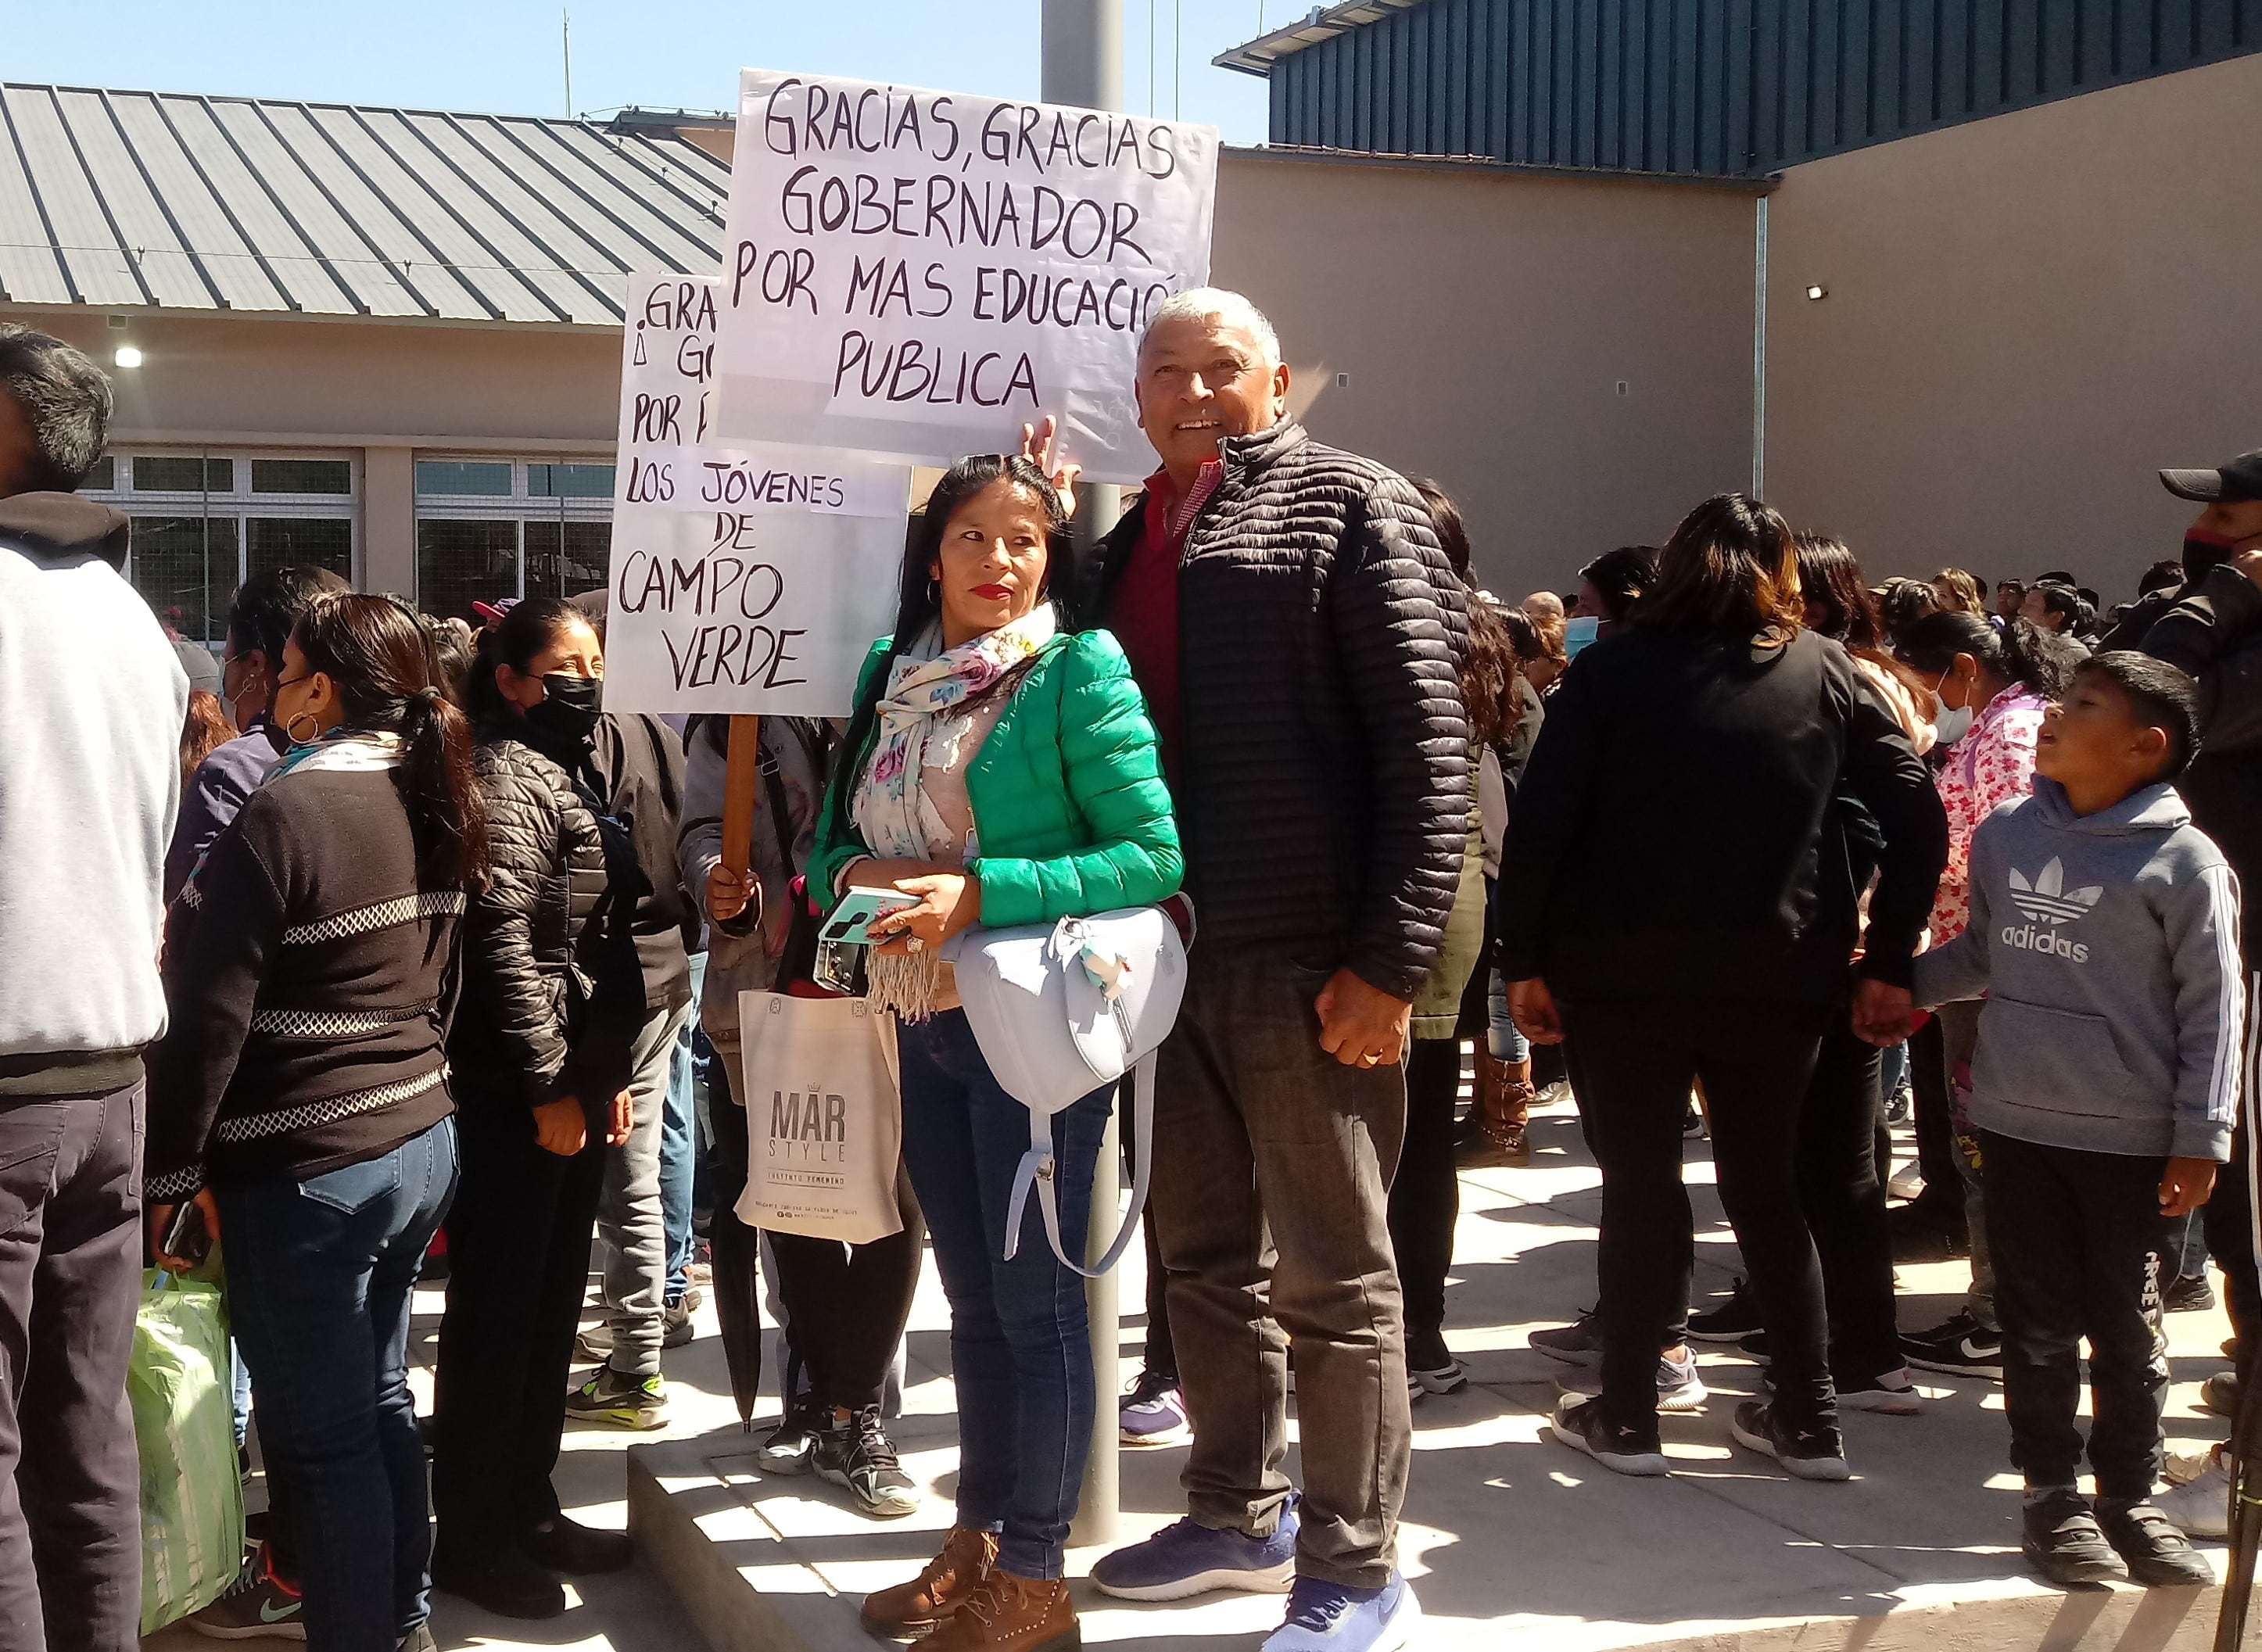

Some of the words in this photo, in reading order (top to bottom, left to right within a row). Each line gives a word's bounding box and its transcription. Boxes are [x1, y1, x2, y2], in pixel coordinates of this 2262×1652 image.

[981, 101, 1174, 179] GRACIAS
[783, 166, 1152, 264] GOBERNADOR
[733, 241, 818, 316] POR
[845, 255, 952, 317] MAS
[973, 267, 1176, 332] EDUCACIÓ
[678, 335, 714, 384] G
[834, 331, 1039, 407] PUBLICA
[633, 393, 681, 446] POR
[626, 457, 674, 502] LOS
[702, 460, 844, 507] JÓVENES
[709, 512, 755, 554] DE
[619, 551, 783, 620] CAMPO
[661, 625, 808, 691] VERDE
[2002, 924, 2089, 963] adidas
[769, 1140, 844, 1162] STYLE
